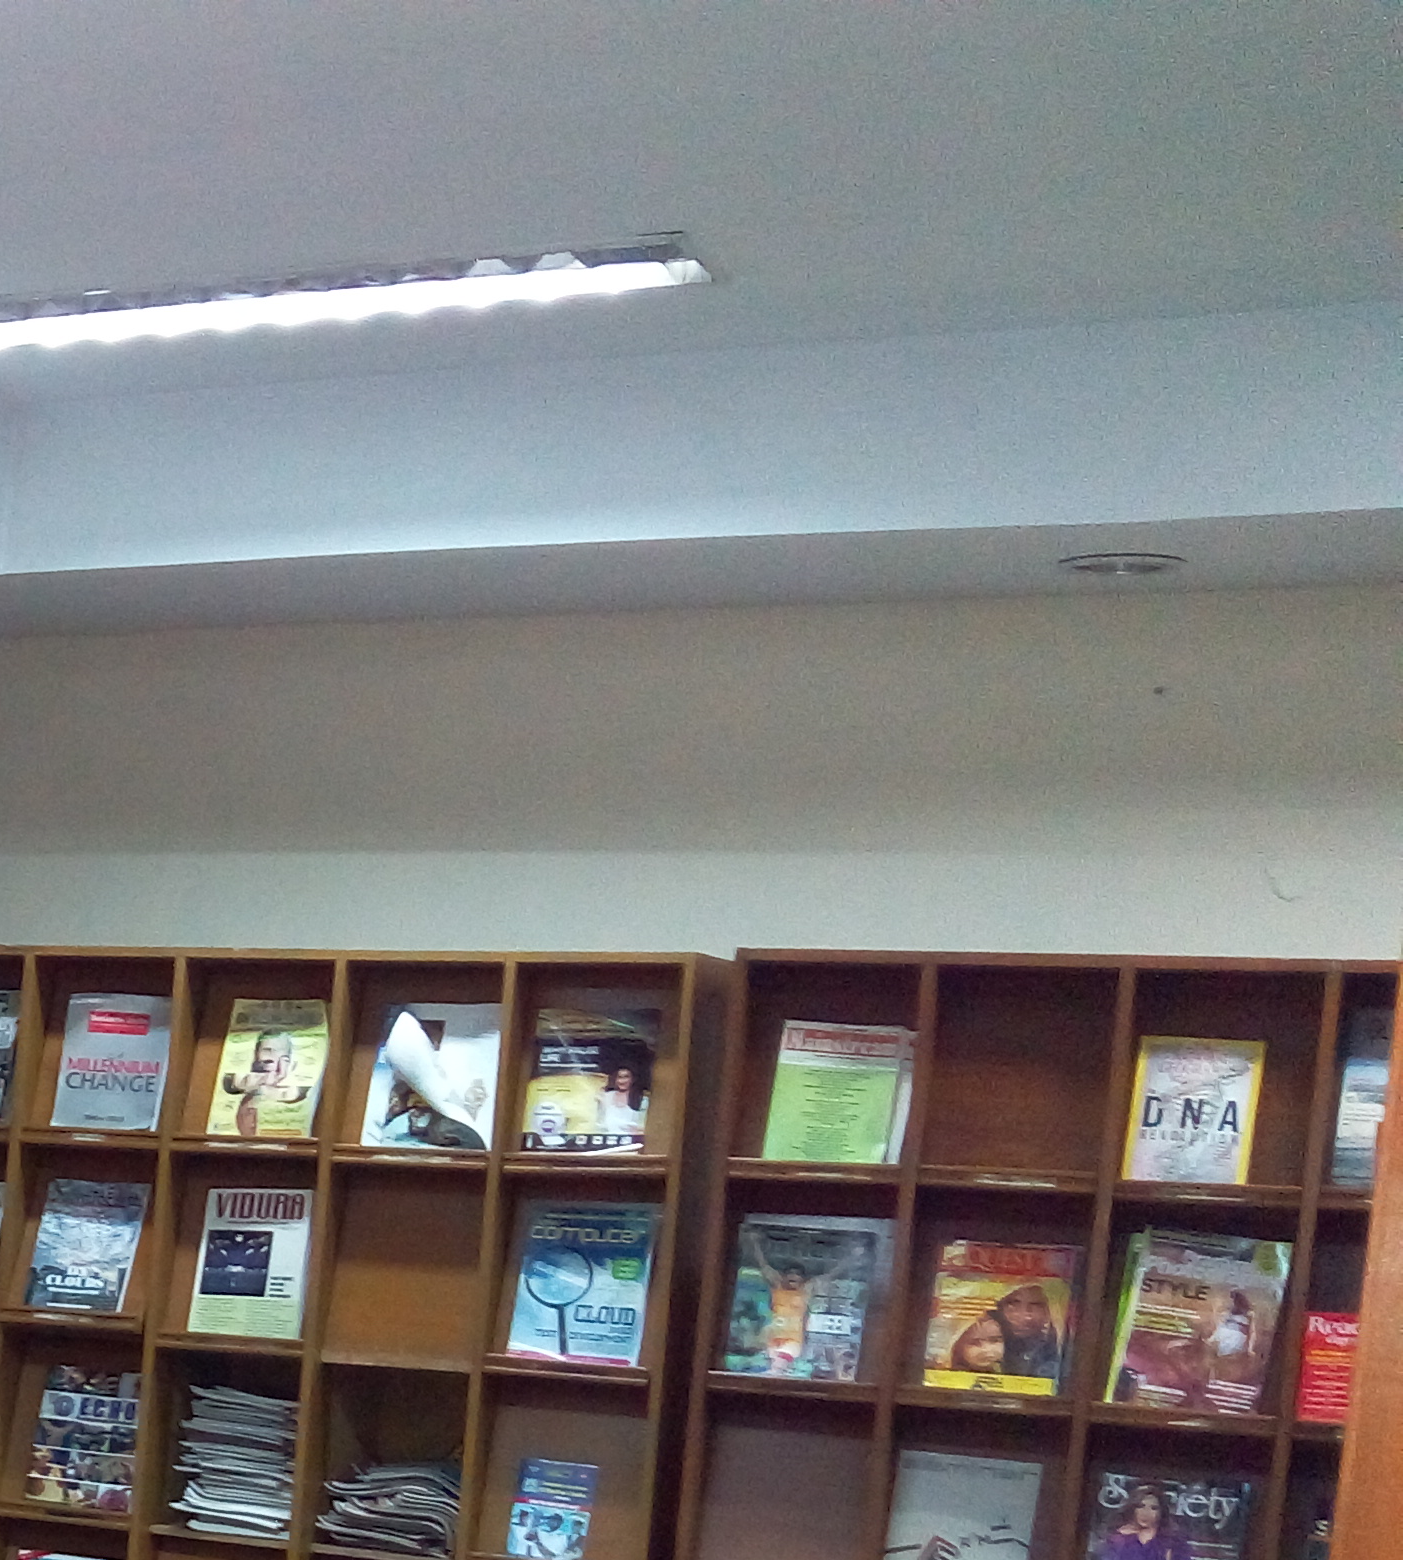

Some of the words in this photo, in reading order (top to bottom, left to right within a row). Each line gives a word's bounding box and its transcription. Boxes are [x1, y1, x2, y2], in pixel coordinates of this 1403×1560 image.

[67, 1056, 161, 1075] MILLENNIUM
[64, 1072, 157, 1093] CHANGE
[216, 1192, 306, 1221] VIDURA
[1141, 1278, 1211, 1302] STYLE
[1098, 1473, 1240, 1530] Siety
